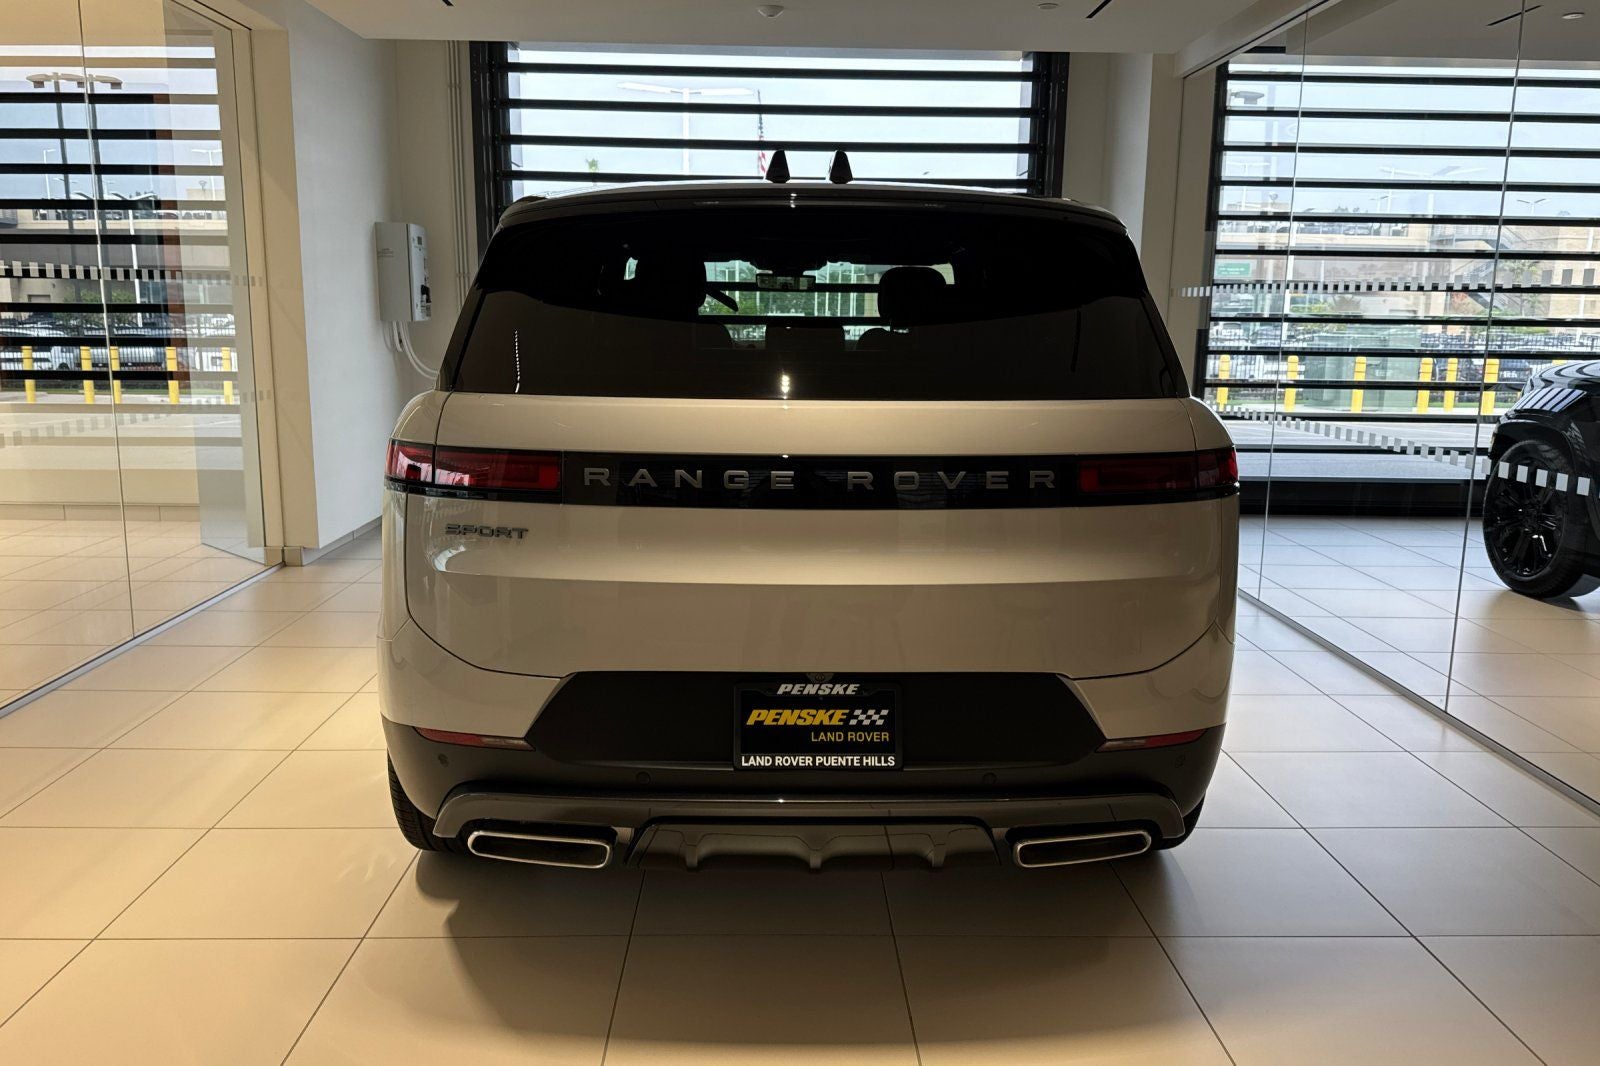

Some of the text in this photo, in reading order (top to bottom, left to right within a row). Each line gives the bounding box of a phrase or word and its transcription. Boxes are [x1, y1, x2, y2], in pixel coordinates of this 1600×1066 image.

[584, 467, 1055, 490] RANGE ROVER
[445, 523, 529, 539] SPORT
[776, 683, 860, 695] PENSKE
[746, 709, 849, 726] PENSKE
[811, 731, 889, 742] LAND ROVER
[741, 756, 895, 766] LAND ROVER PUENTE HILLS
